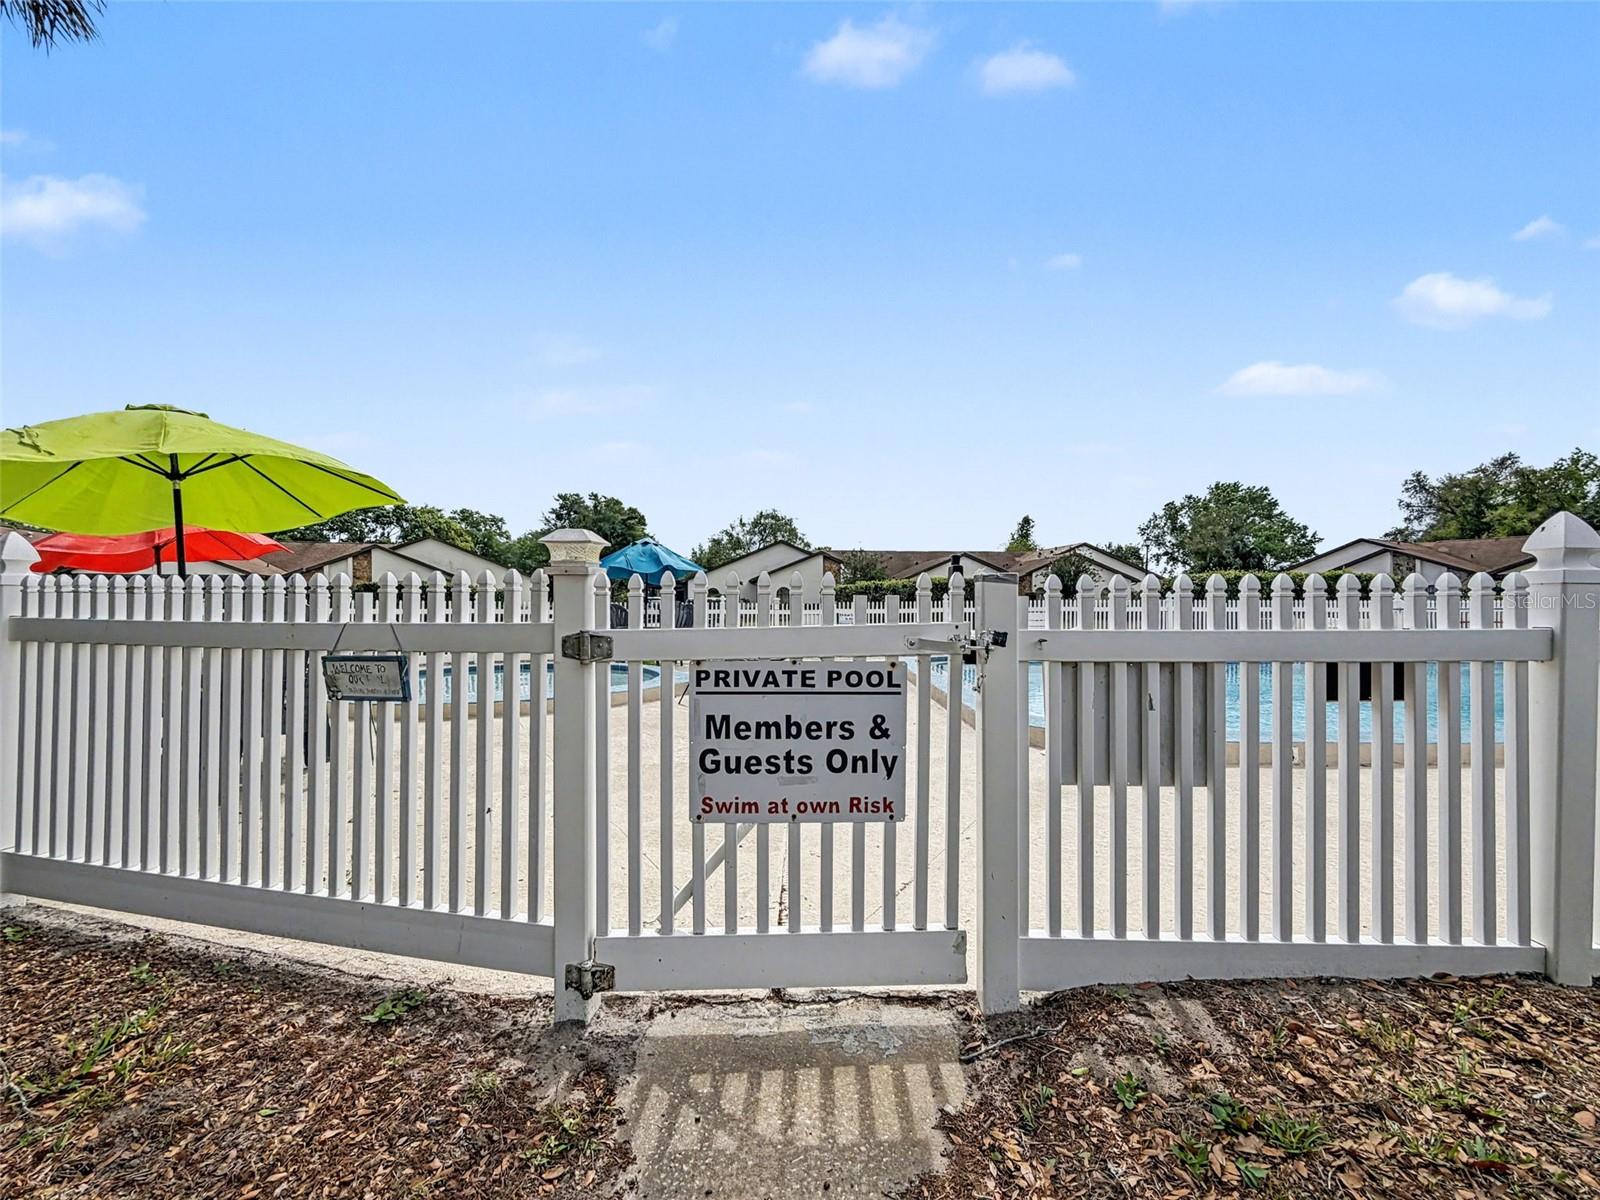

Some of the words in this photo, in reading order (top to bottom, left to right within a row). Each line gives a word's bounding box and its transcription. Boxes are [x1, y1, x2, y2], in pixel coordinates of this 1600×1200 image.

[332, 662, 373, 675] WELCOME
[374, 663, 386, 674] TO
[695, 670, 816, 688] PRIVATE
[827, 670, 902, 688] POOL
[705, 714, 855, 740] Members
[869, 714, 891, 740] &
[698, 748, 813, 775] Guests
[826, 748, 898, 781] Only
[701, 796, 759, 814] Swim
[767, 797, 789, 814] at
[796, 801, 840, 814] own
[849, 797, 894, 814] Risk
